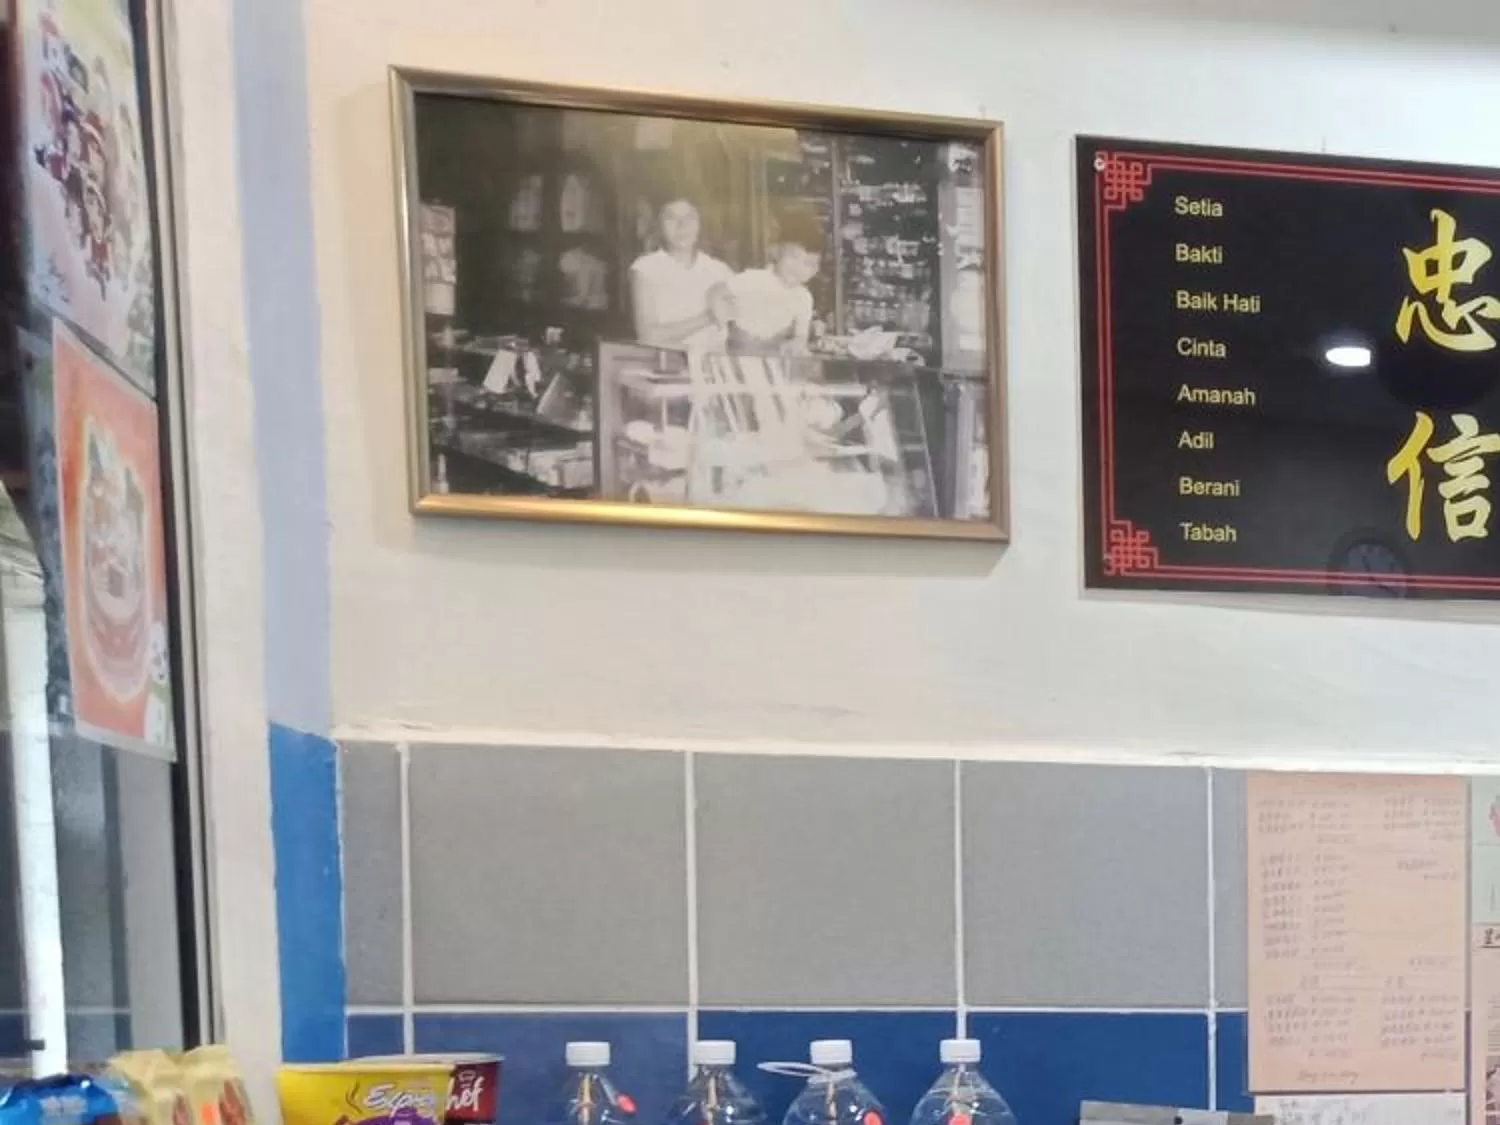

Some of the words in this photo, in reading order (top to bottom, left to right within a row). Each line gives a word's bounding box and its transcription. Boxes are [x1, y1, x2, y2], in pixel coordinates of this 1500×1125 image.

[1174, 195, 1224, 218] Setia
[1174, 243, 1223, 265] Bakti
[1176, 289, 1219, 311] Baik
[1223, 293, 1261, 314] Hati
[1177, 336, 1227, 358] Cinta
[1177, 383, 1256, 406] Amanah
[1177, 430, 1214, 450] Adil
[1179, 476, 1241, 498] Berani
[1179, 521, 1238, 544] Tabah
